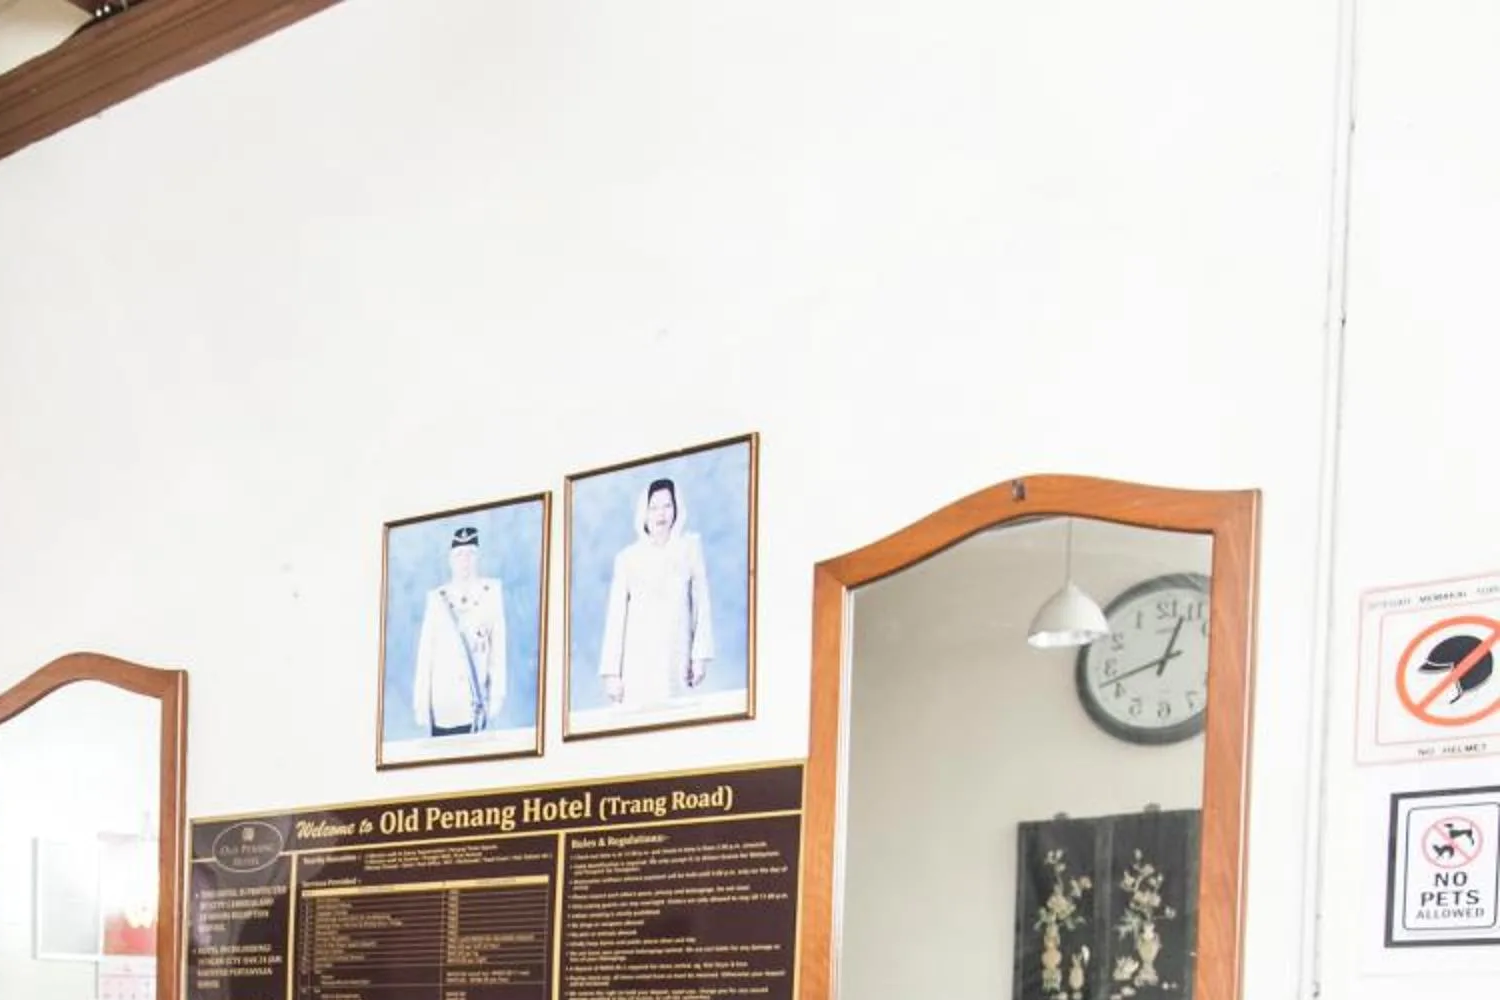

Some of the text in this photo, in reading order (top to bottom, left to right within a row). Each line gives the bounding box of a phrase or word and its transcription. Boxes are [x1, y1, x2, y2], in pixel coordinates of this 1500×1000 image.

[295, 785, 733, 839] Welcome to Old Penang Hotel (Trang Road)
[1434, 871, 1468, 887] NO
[1420, 889, 1480, 907] PETS
[1415, 907, 1485, 919] ALLOWED
